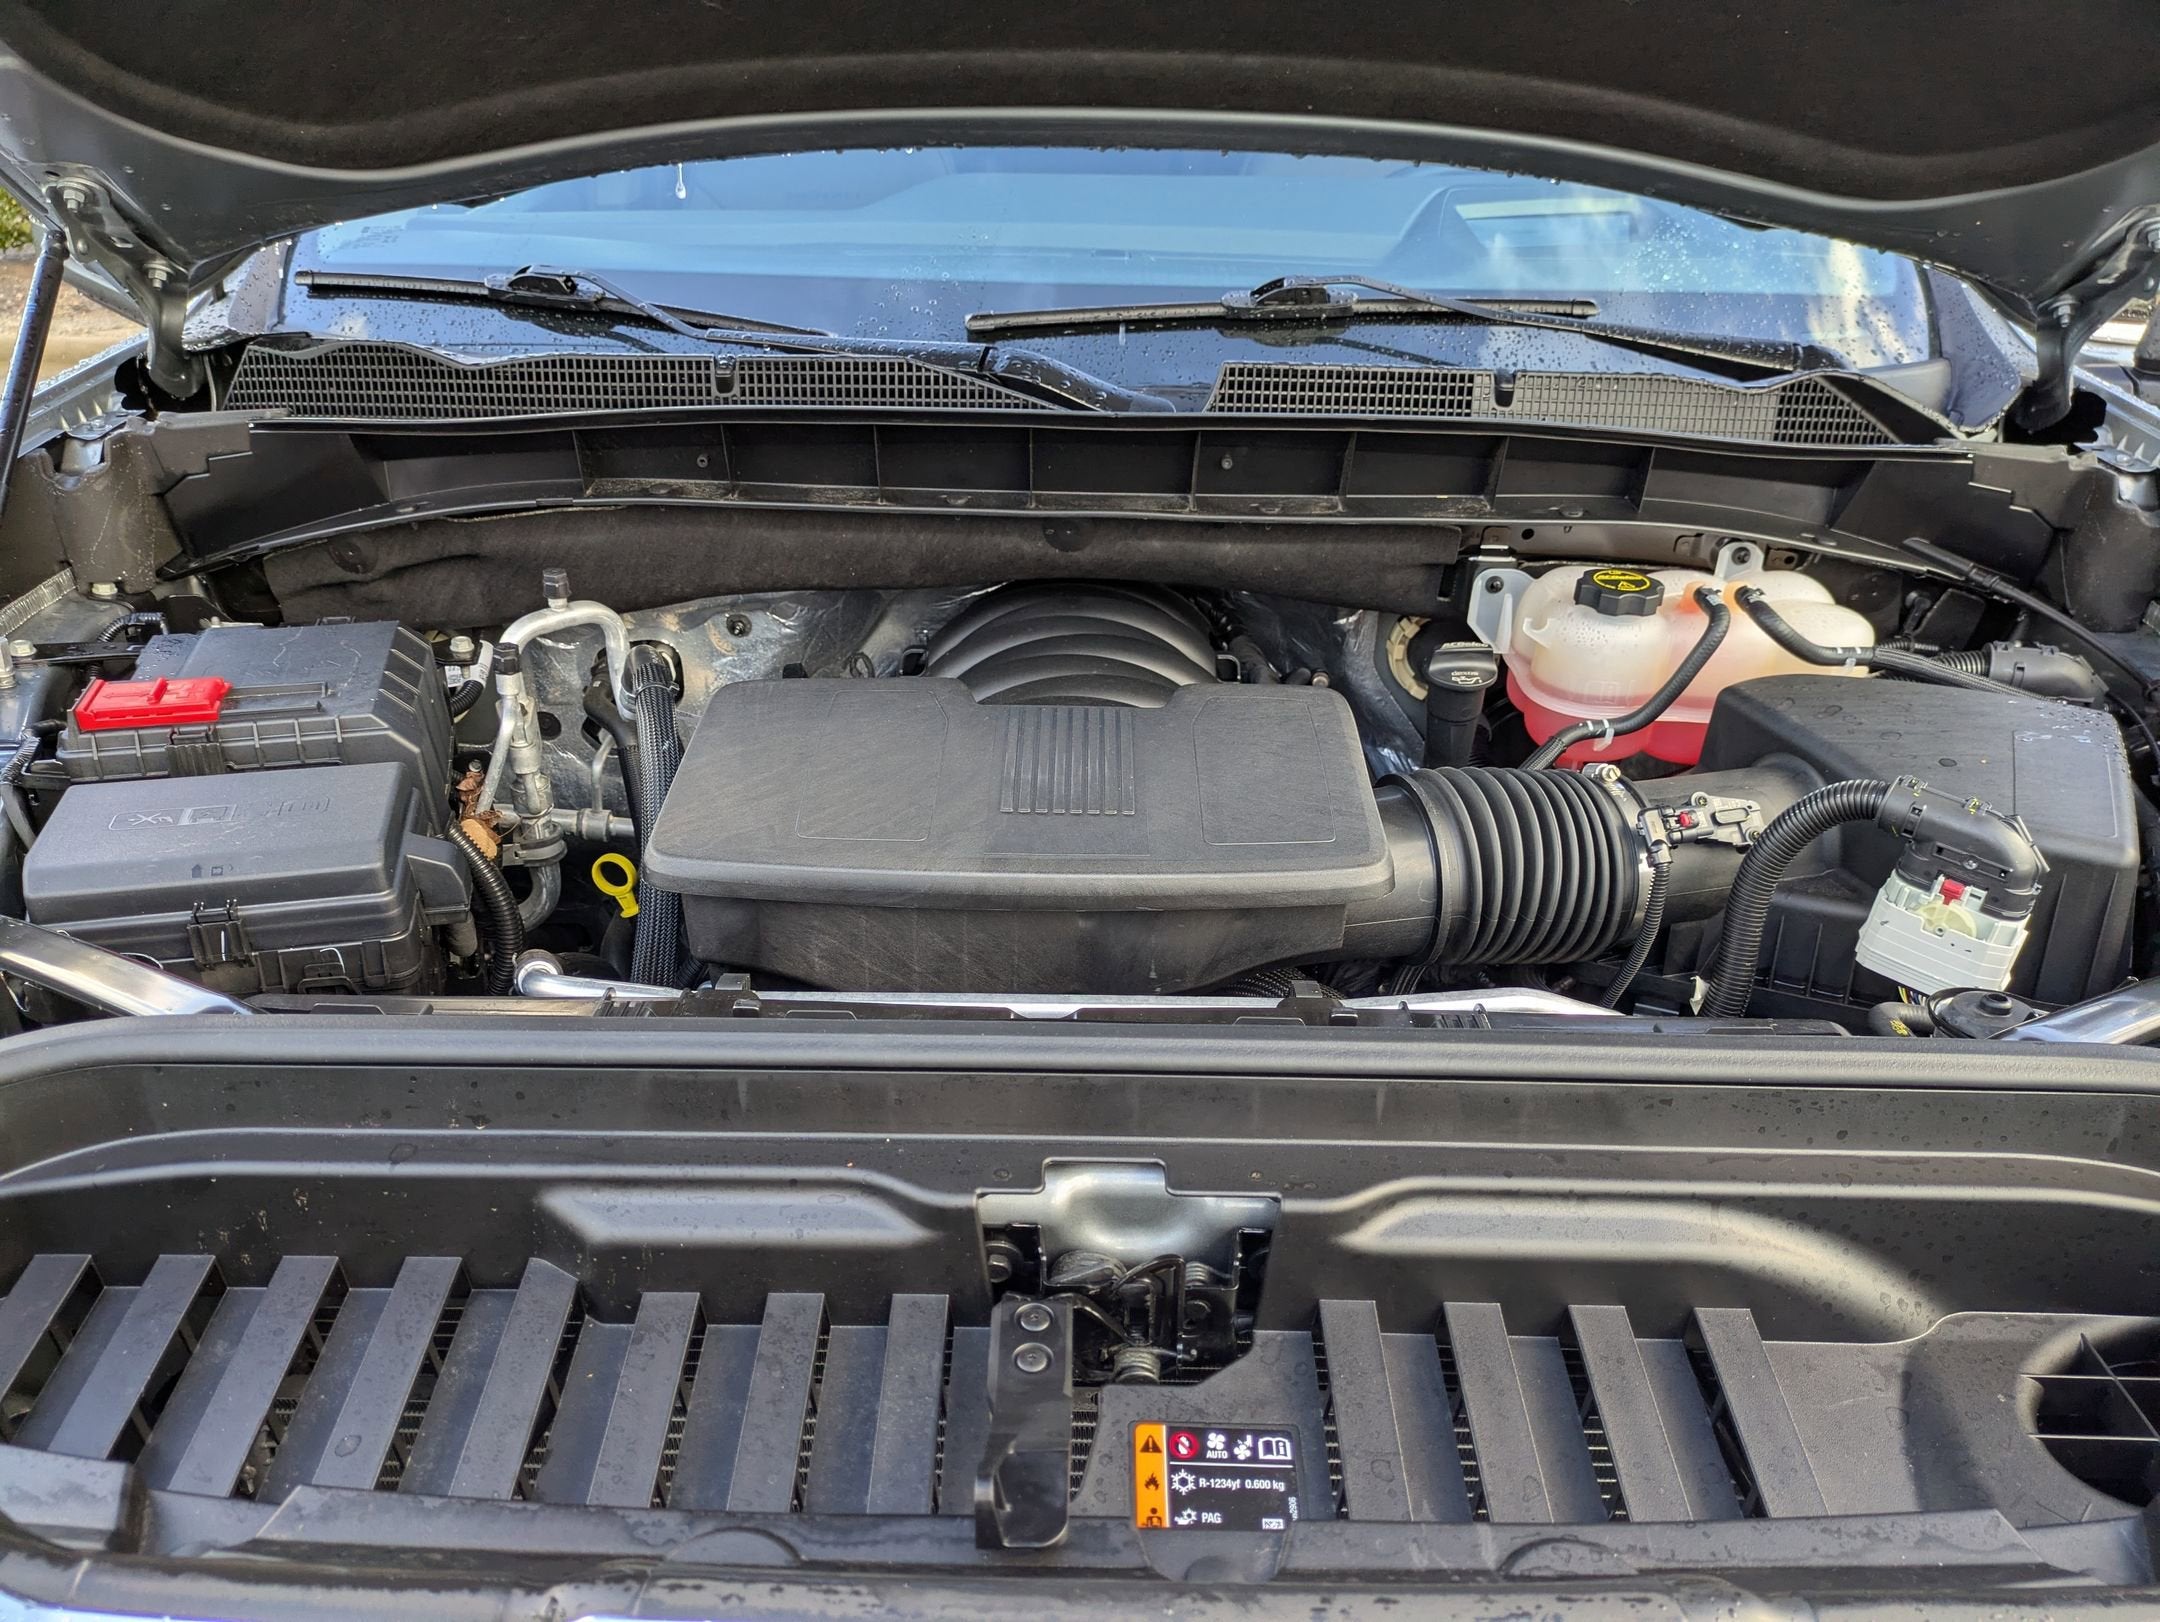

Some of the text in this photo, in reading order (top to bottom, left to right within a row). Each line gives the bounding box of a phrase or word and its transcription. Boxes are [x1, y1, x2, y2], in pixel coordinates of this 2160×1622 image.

[1206, 1450, 1228, 1459] AUTO
[1199, 1478, 1285, 1491] R-1234yf 0.600 kg
[1201, 1512, 1222, 1523] PAG
